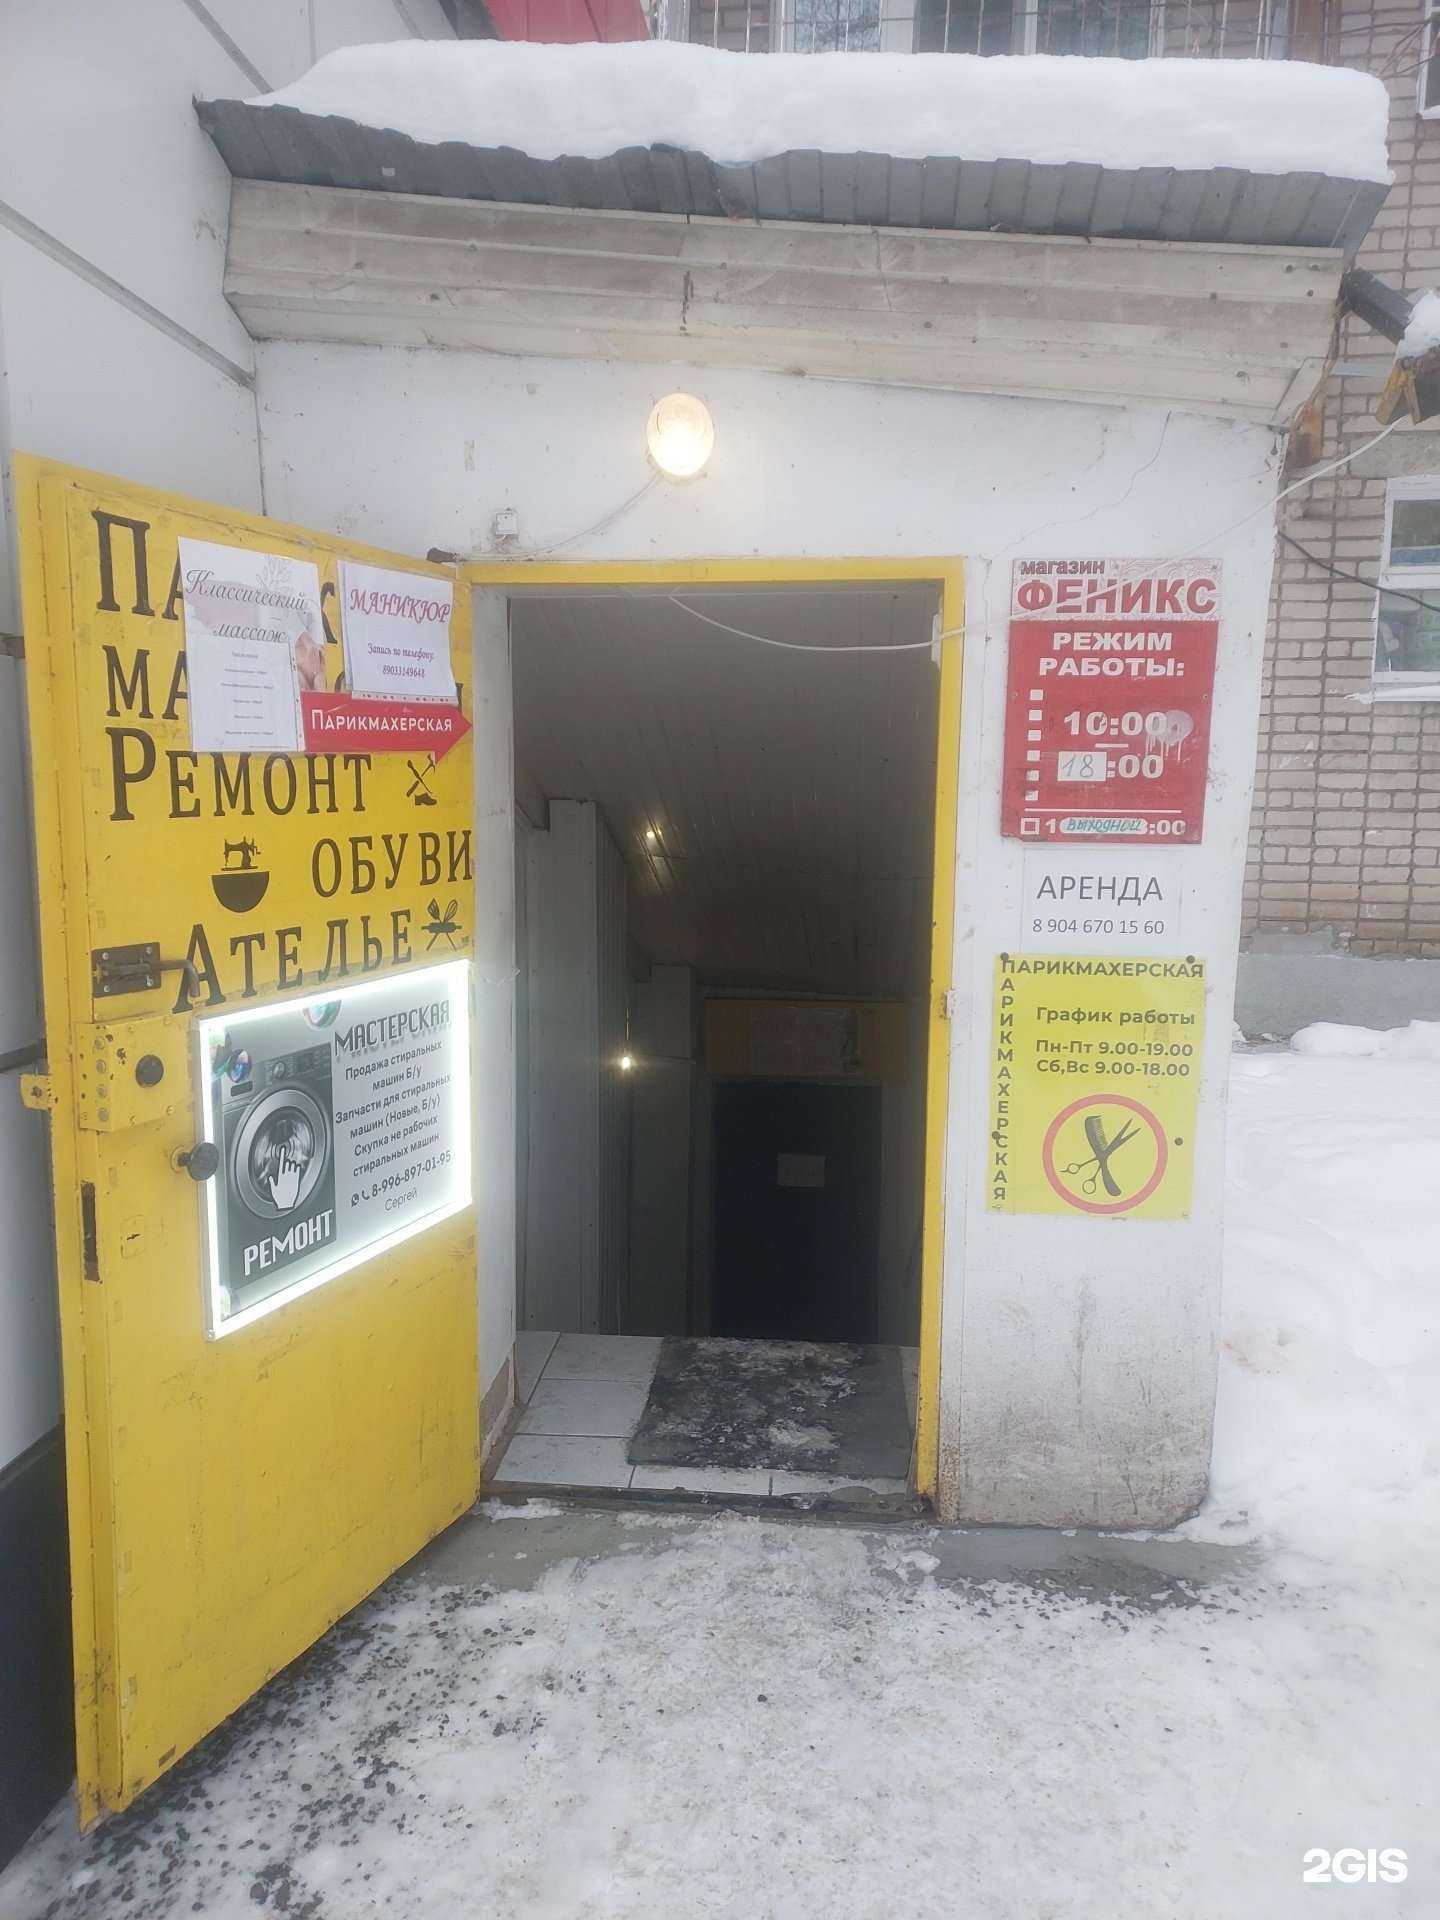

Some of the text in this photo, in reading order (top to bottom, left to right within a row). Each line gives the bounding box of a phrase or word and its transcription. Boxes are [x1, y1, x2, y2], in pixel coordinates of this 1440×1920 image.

[1021, 560, 1105, 575] магазин
[186, 570, 305, 610] Классический
[1017, 578, 1217, 614] ФЕНИКС
[350, 588, 451, 624] МАНИКЮР
[213, 623, 288, 643] массаж
[1053, 632, 1172, 650] РЕЖИМ
[367, 642, 391, 656] Запись
[393, 648, 401, 656] по
[1039, 658, 1185, 676] РАБОТЫ:
[1063, 711, 1168, 736] 10:00
[312, 830, 472, 897] ОБУВИ
[1036, 875, 1163, 906] АРЕНДА
[1032, 919, 1165, 934] 8 904 670 15 60
[172, 909, 412, 1014] АТЕЛЬЕ
[1002, 959, 1203, 978] ПАРИКМАХЕРСКАЯ
[334, 1000, 450, 1056] МАСТЕРСКАЯ
[1036, 1006, 1195, 1026] График работы
[345, 1041, 442, 1080] Продажа стиральных
[1036, 1040, 1194, 1056] Пн-Пт 9.00-19.00
[372, 1072, 404, 1092] машин
[1036, 1059, 1190, 1077] Сб,Вс 9.00-18.00
[336, 1075, 451, 1124] Запчасти для стиральных
[350, 1119, 383, 1139] машин
[386, 1105, 420, 1127] (Новые,
[354, 1115, 438, 1156] Скупка не рабочих
[353, 1133, 439, 1177] стиральных машин
[372, 1150, 451, 1197] 8-996-897-01-95
[384, 1188, 417, 1211] Сергей
[244, 1209, 333, 1276] РЕМОНТ
